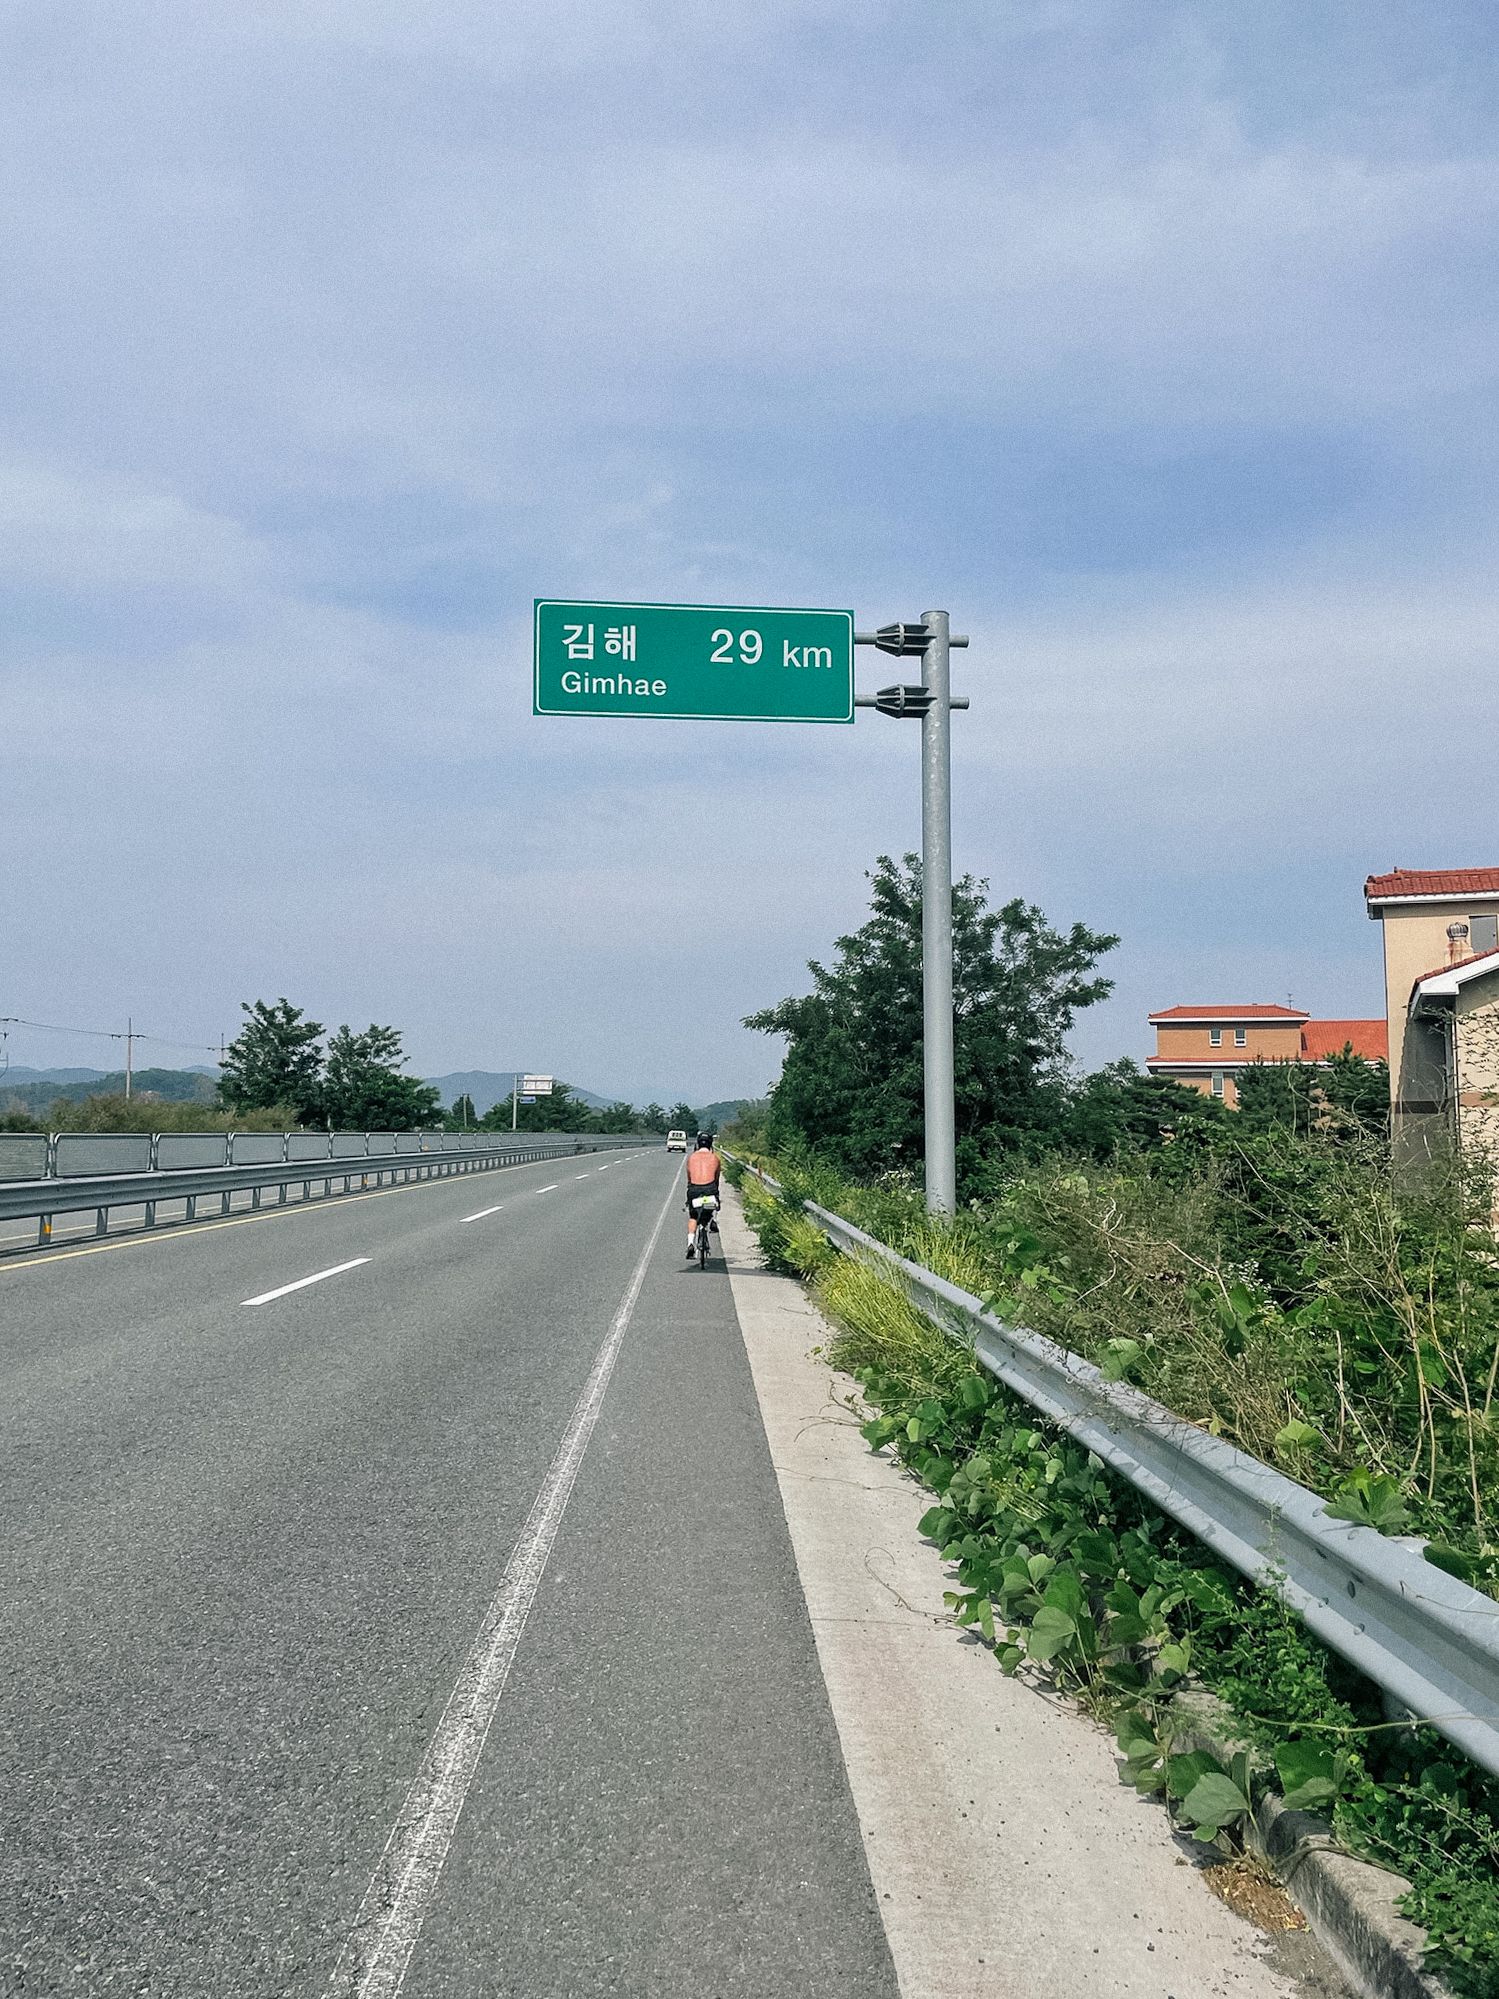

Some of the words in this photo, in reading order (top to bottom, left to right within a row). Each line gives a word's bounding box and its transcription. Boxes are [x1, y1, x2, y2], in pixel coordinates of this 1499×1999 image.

[561, 623, 636, 662] 김해
[710, 628, 763, 665] 29
[783, 640, 833, 669] km
[561, 671, 667, 696] Gimhae
